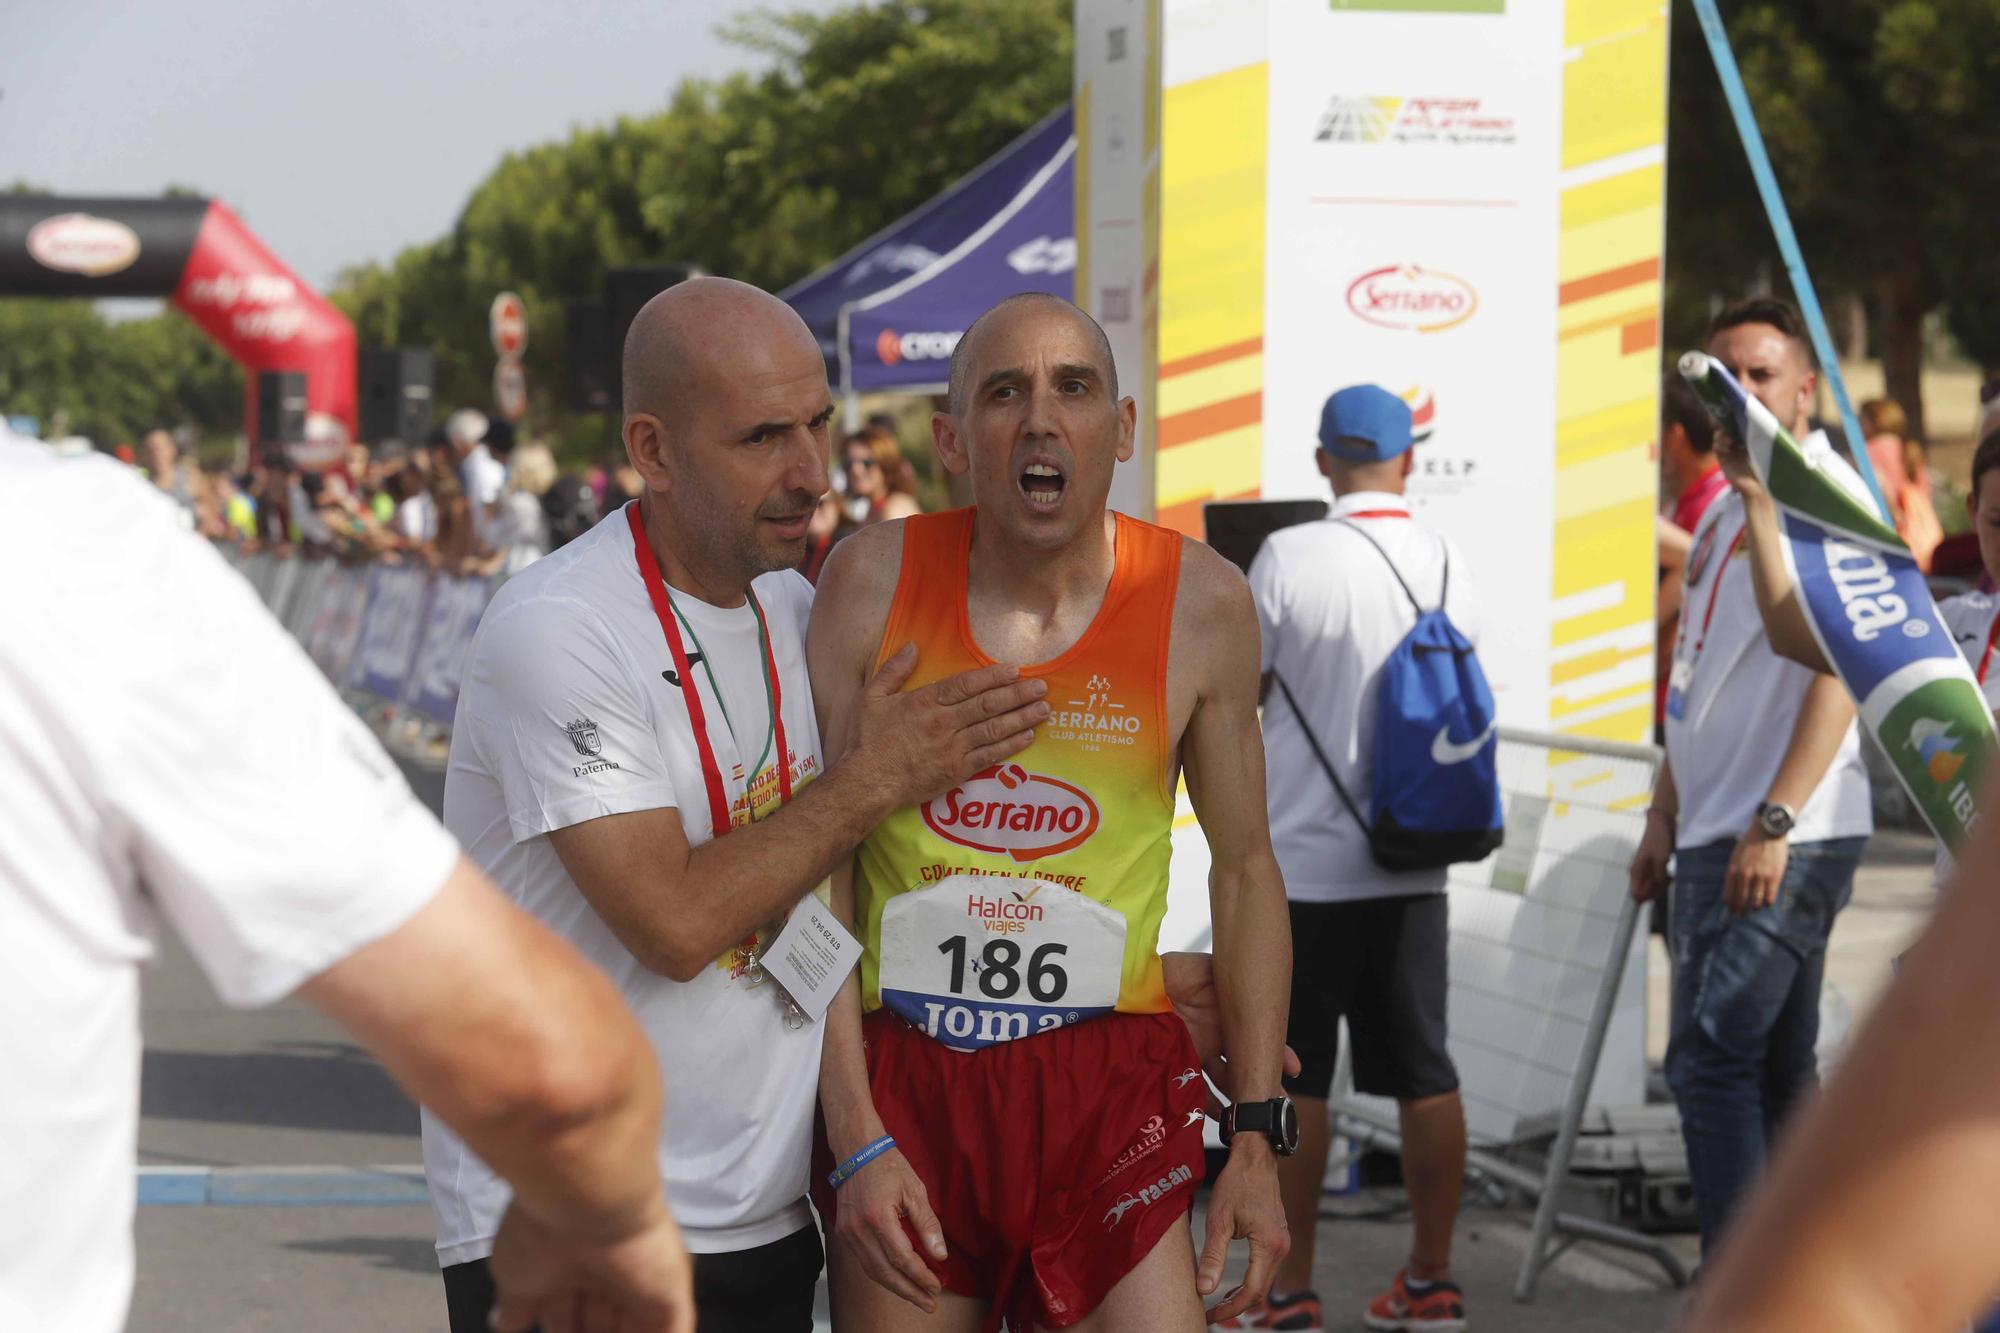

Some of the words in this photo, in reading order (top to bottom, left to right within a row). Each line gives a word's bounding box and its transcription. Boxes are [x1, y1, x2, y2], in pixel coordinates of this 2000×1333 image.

[1365, 281, 1465, 313] Serrano
[1822, 538, 1909, 642] ma
[1047, 710, 1141, 733] SERRANO
[1049, 730, 1076, 740] CLUB
[1077, 732, 1135, 745] ATLETISMO
[572, 762, 620, 777] Paterna
[937, 787, 1084, 833] Serrano
[984, 919, 1026, 936] viajes
[937, 935, 1068, 1003] 186
[1138, 1164, 1193, 1206] rasán
